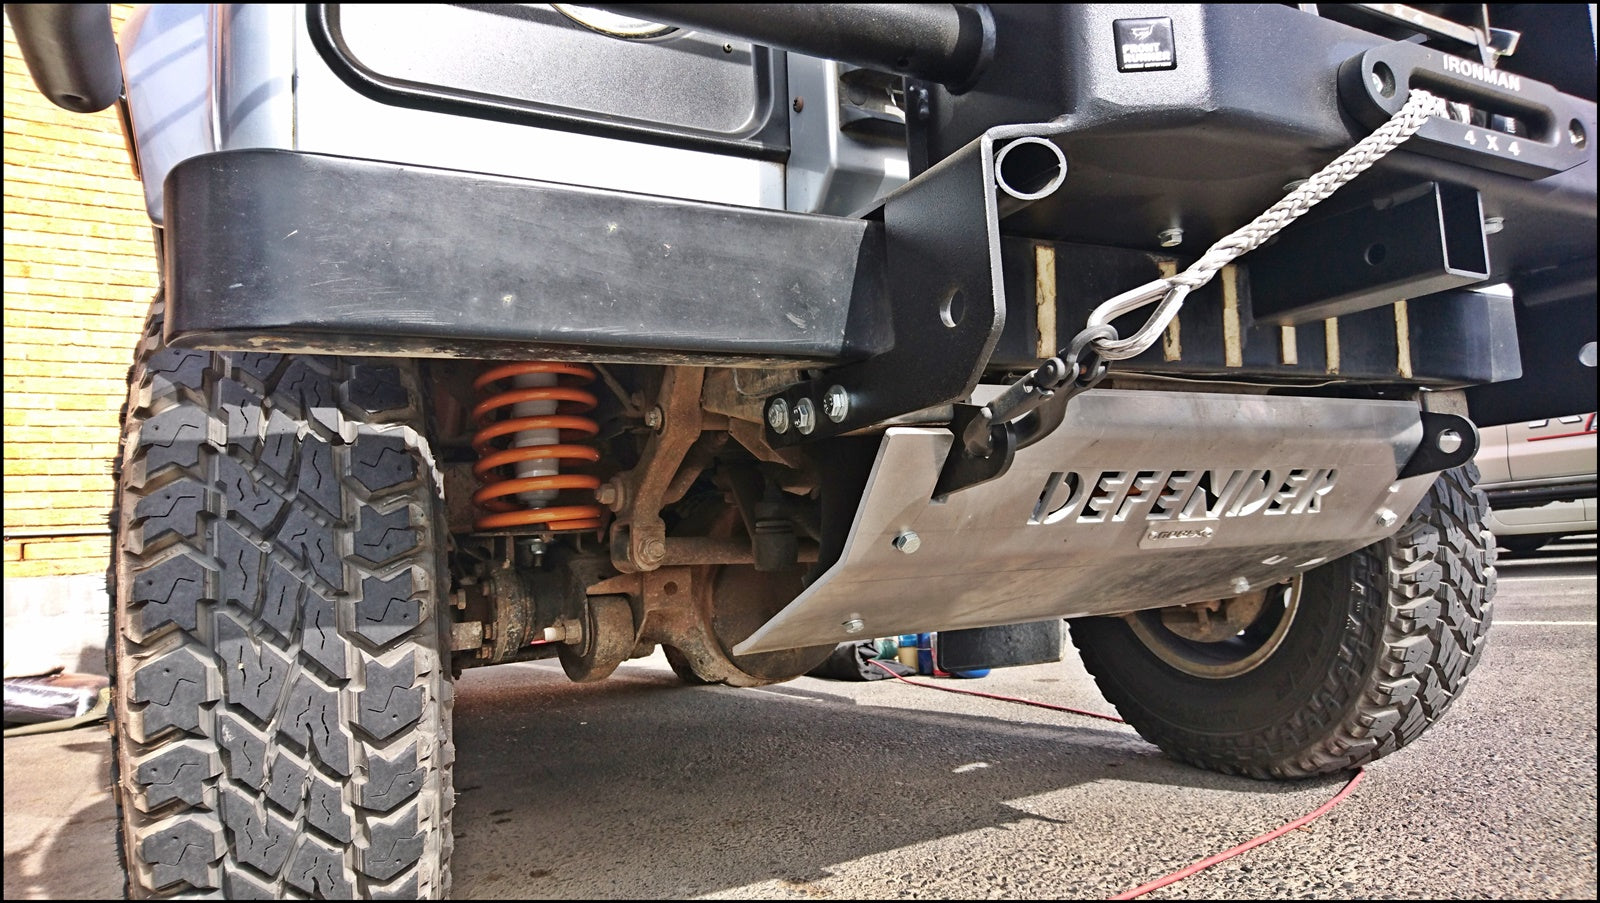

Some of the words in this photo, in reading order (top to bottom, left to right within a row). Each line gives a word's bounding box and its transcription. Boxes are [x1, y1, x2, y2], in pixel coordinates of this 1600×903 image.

[1122, 43, 1160, 54] FRONT
[1443, 54, 1520, 91] IRONMAN
[1026, 468, 1339, 525] DEFENDER
